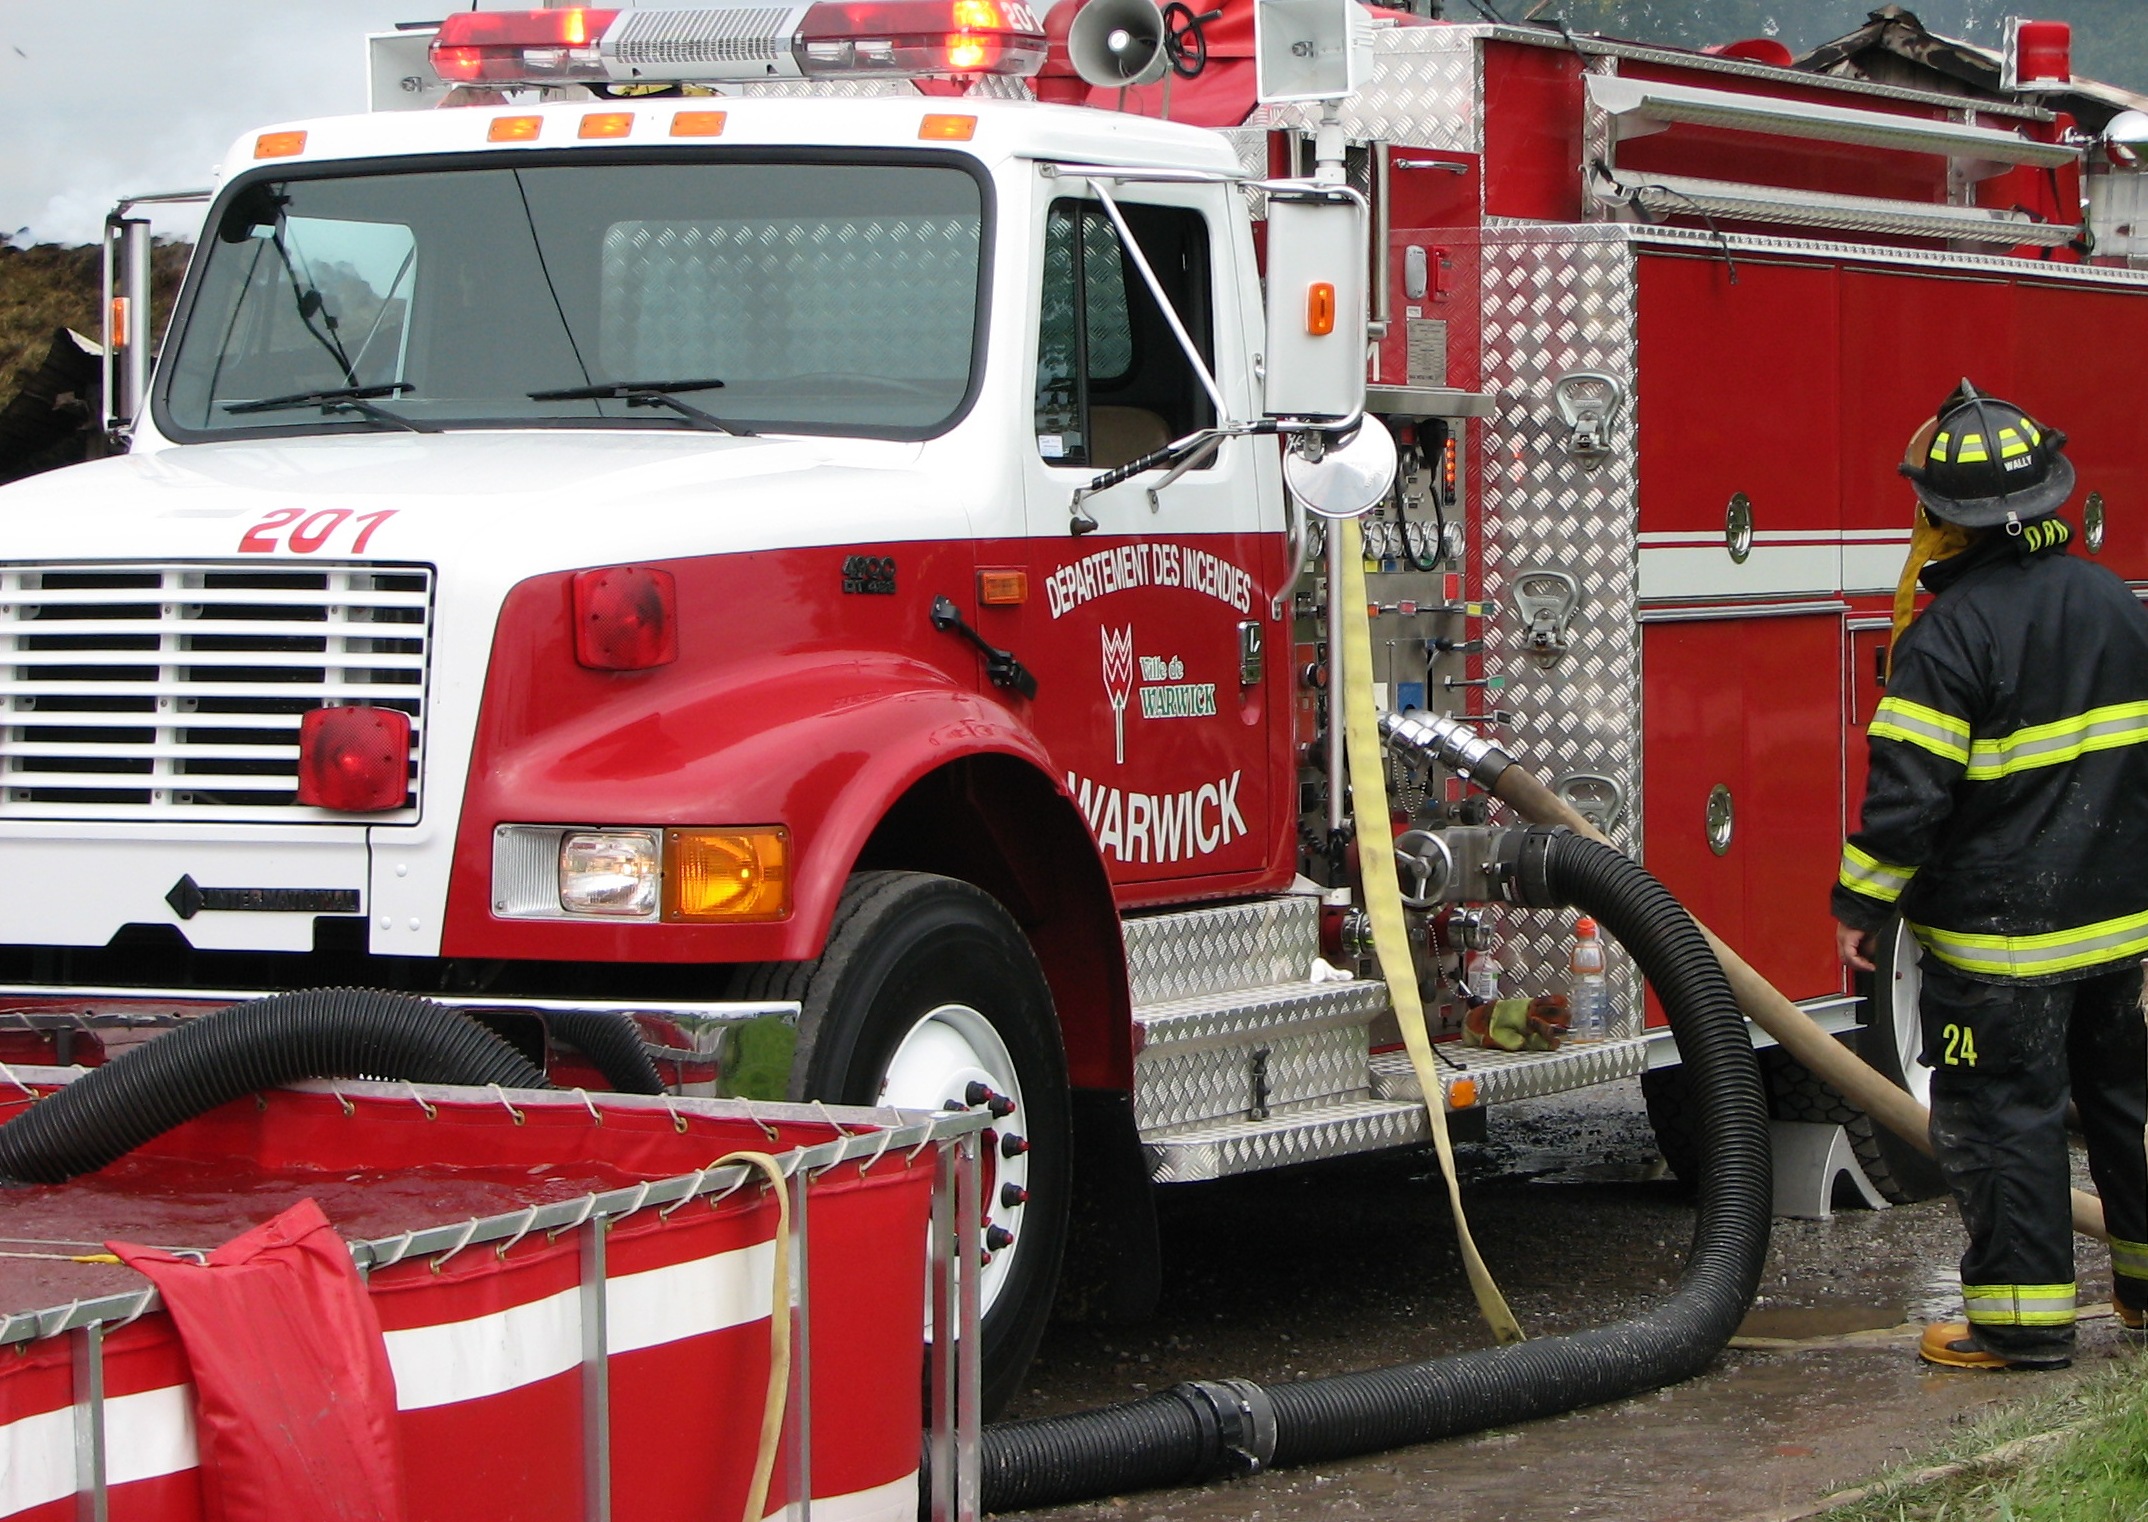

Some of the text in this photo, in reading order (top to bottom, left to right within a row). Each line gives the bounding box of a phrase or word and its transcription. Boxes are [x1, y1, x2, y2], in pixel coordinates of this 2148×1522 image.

[1000, 1, 1045, 34] 201
[2004, 456, 2032, 471] WALLY
[237, 508, 401, 553] 201
[1045, 543, 1252, 619] DÉPARTEMENT DES INCENDIES
[1140, 655, 1184, 681] Ville de
[1140, 684, 1216, 718] WARWICK
[1067, 769, 1248, 863] WARWICK
[1943, 1023, 1978, 1067] 24
